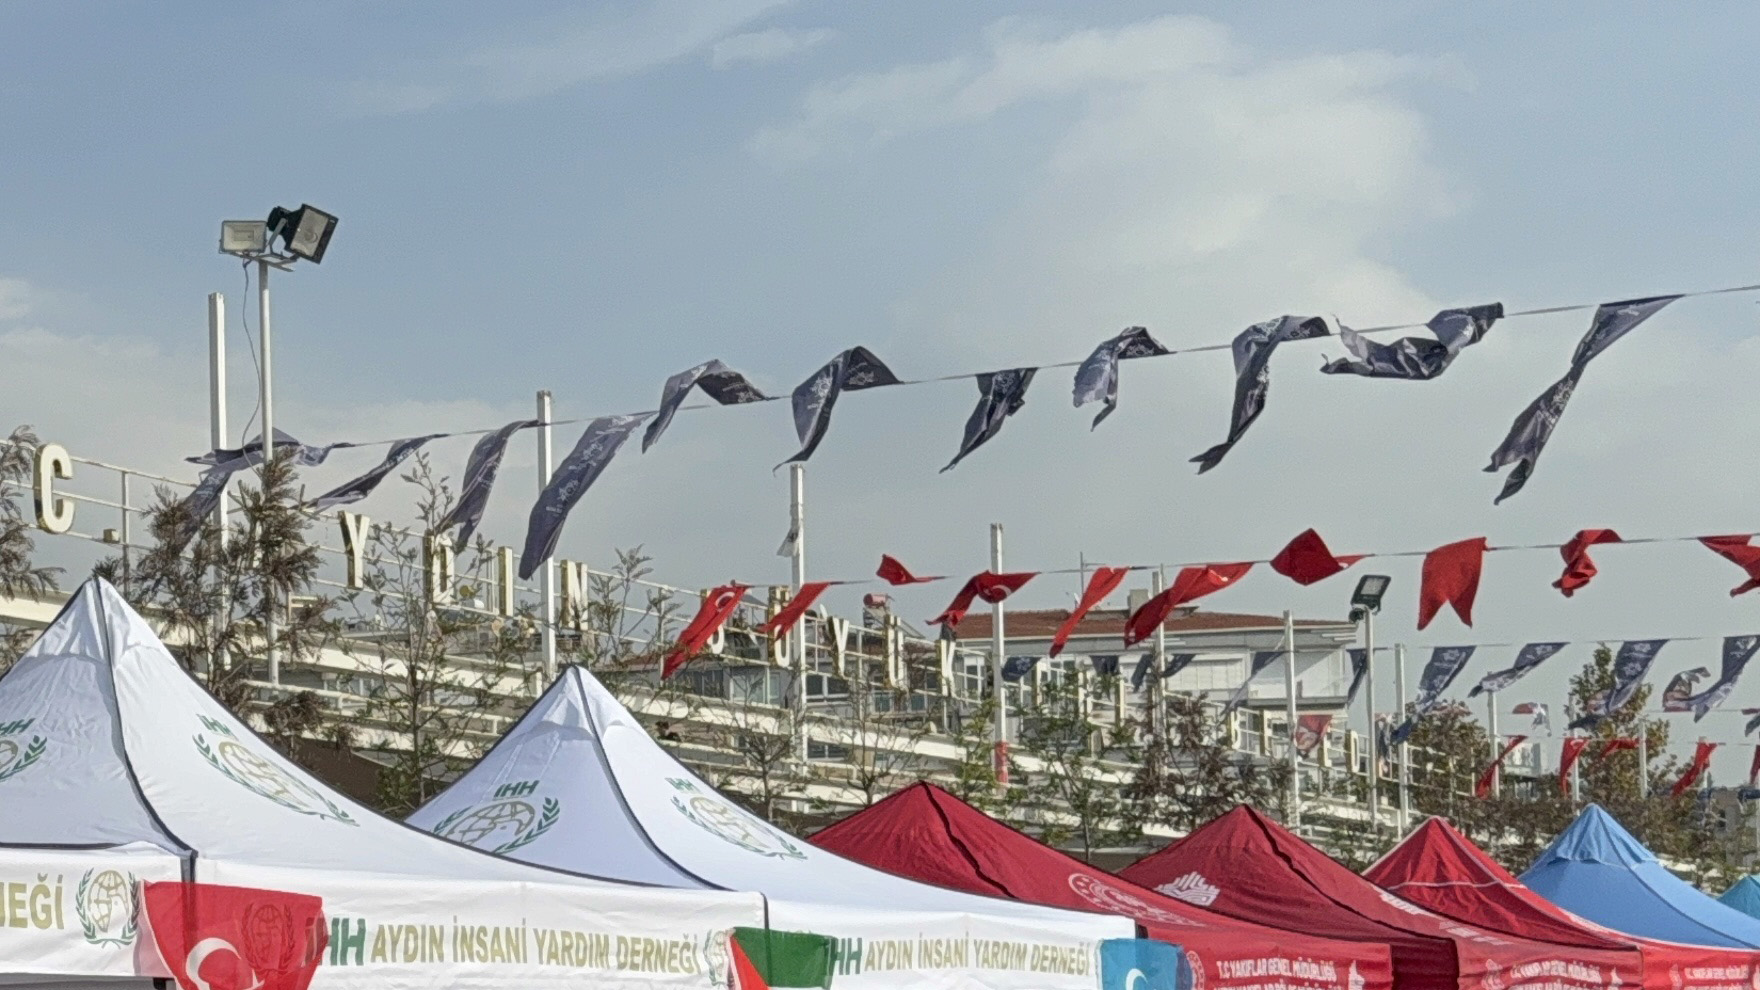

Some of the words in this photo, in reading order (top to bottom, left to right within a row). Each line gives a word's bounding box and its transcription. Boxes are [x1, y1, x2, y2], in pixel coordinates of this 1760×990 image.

[370, 924, 443, 964] AYDIN
[452, 915, 528, 964] İNSANİ
[533, 928, 611, 968] YARDIM
[615, 933, 702, 975] DERNEĞİ
[864, 939, 913, 972] AYDIN
[918, 931, 970, 969] İNSANİ
[973, 938, 1027, 972] YARDIM
[1030, 940, 1093, 976] DERNEĞİ
